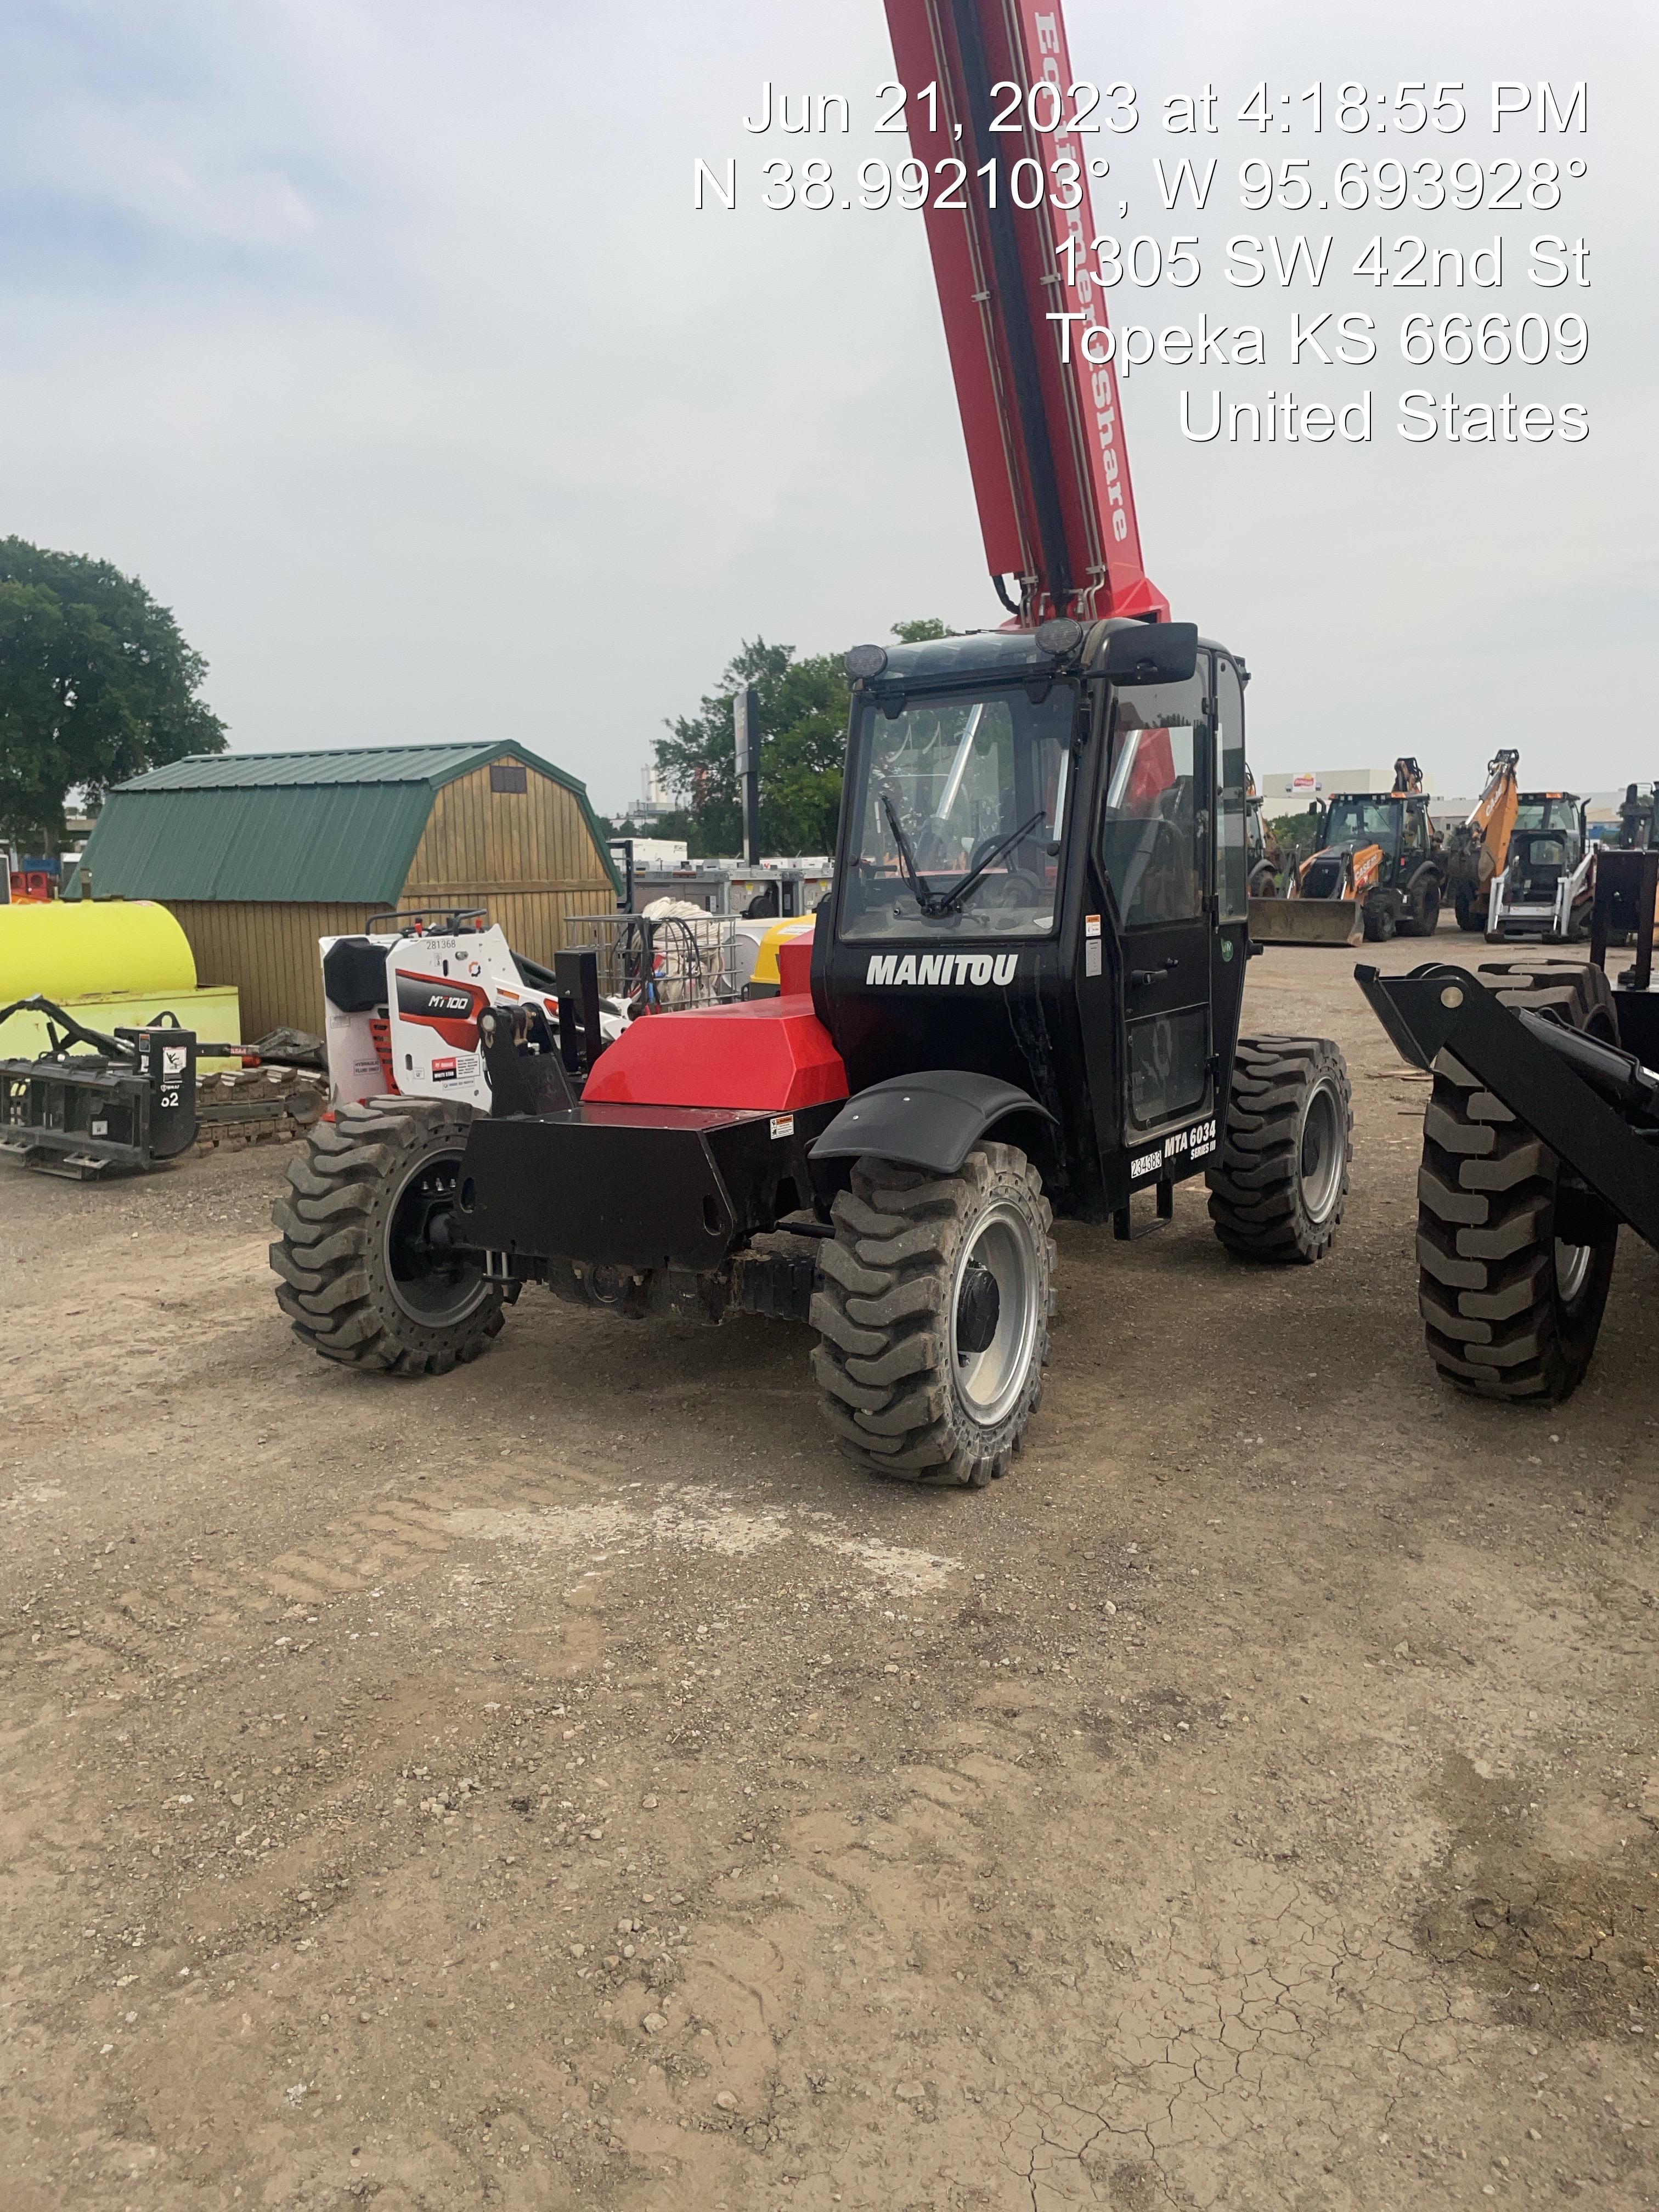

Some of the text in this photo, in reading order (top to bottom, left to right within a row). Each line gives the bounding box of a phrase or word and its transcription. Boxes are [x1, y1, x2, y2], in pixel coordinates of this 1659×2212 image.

[1485, 783, 1502, 817] CASE
[1355, 859, 1372, 881] CASE
[426, 939, 456, 950] 281368
[866, 953, 1019, 986] MANITOU
[428, 995, 469, 1009] MT100
[1164, 1119, 1216, 1159] MTA 6034
[1190, 1142, 1210, 1161] SERIES
[1131, 1151, 1161, 1177] 234383
